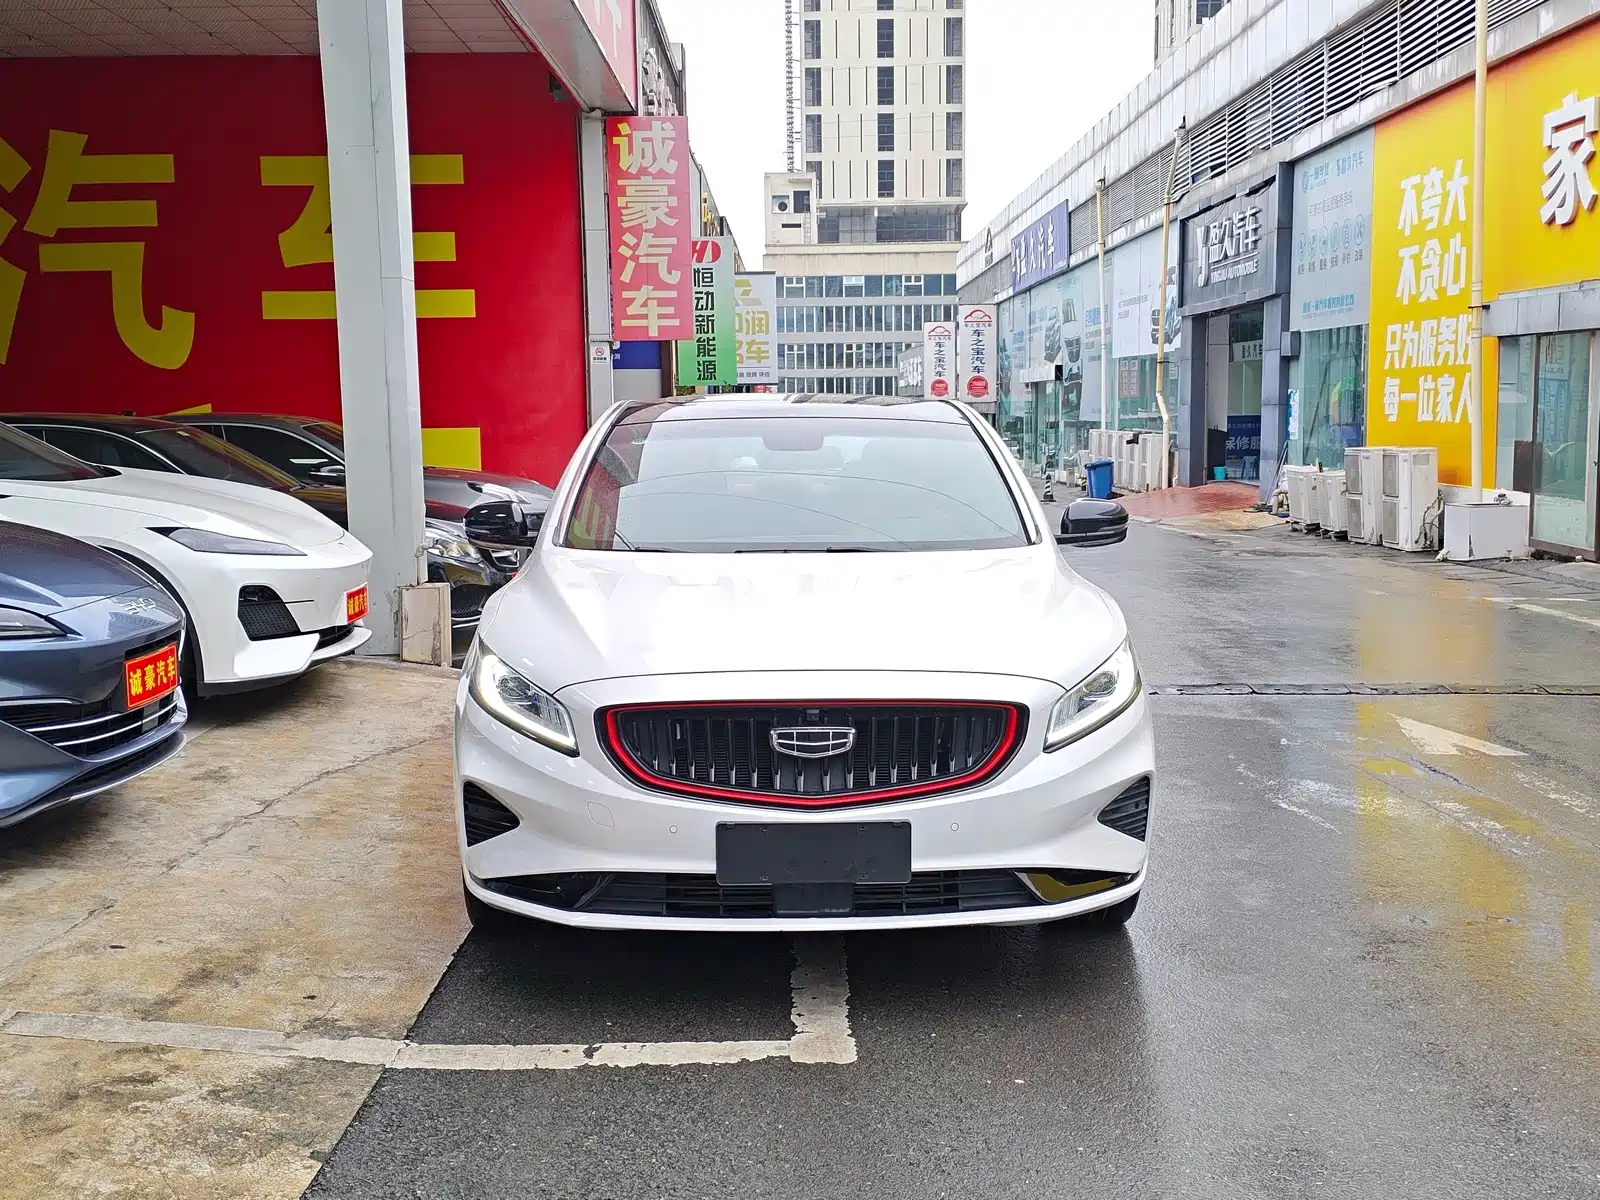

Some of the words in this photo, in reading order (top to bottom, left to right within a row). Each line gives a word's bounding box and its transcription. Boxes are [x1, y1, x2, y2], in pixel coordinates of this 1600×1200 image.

[1540, 91, 1600, 225] 家
[613, 120, 682, 337] 诚豪汽车
[1397, 158, 1468, 236] 不夸大
[1209, 205, 1262, 263] 盈久汽车
[1395, 232, 1467, 305] 不贪心
[693, 267, 716, 381] 恒动新能源
[971, 329, 985, 374] 车之宝汽车
[934, 341, 946, 378] 车之宝汽车
[1384, 373, 1472, 424] 每一位家人
[129, 656, 177, 697] 诚豪汽车
